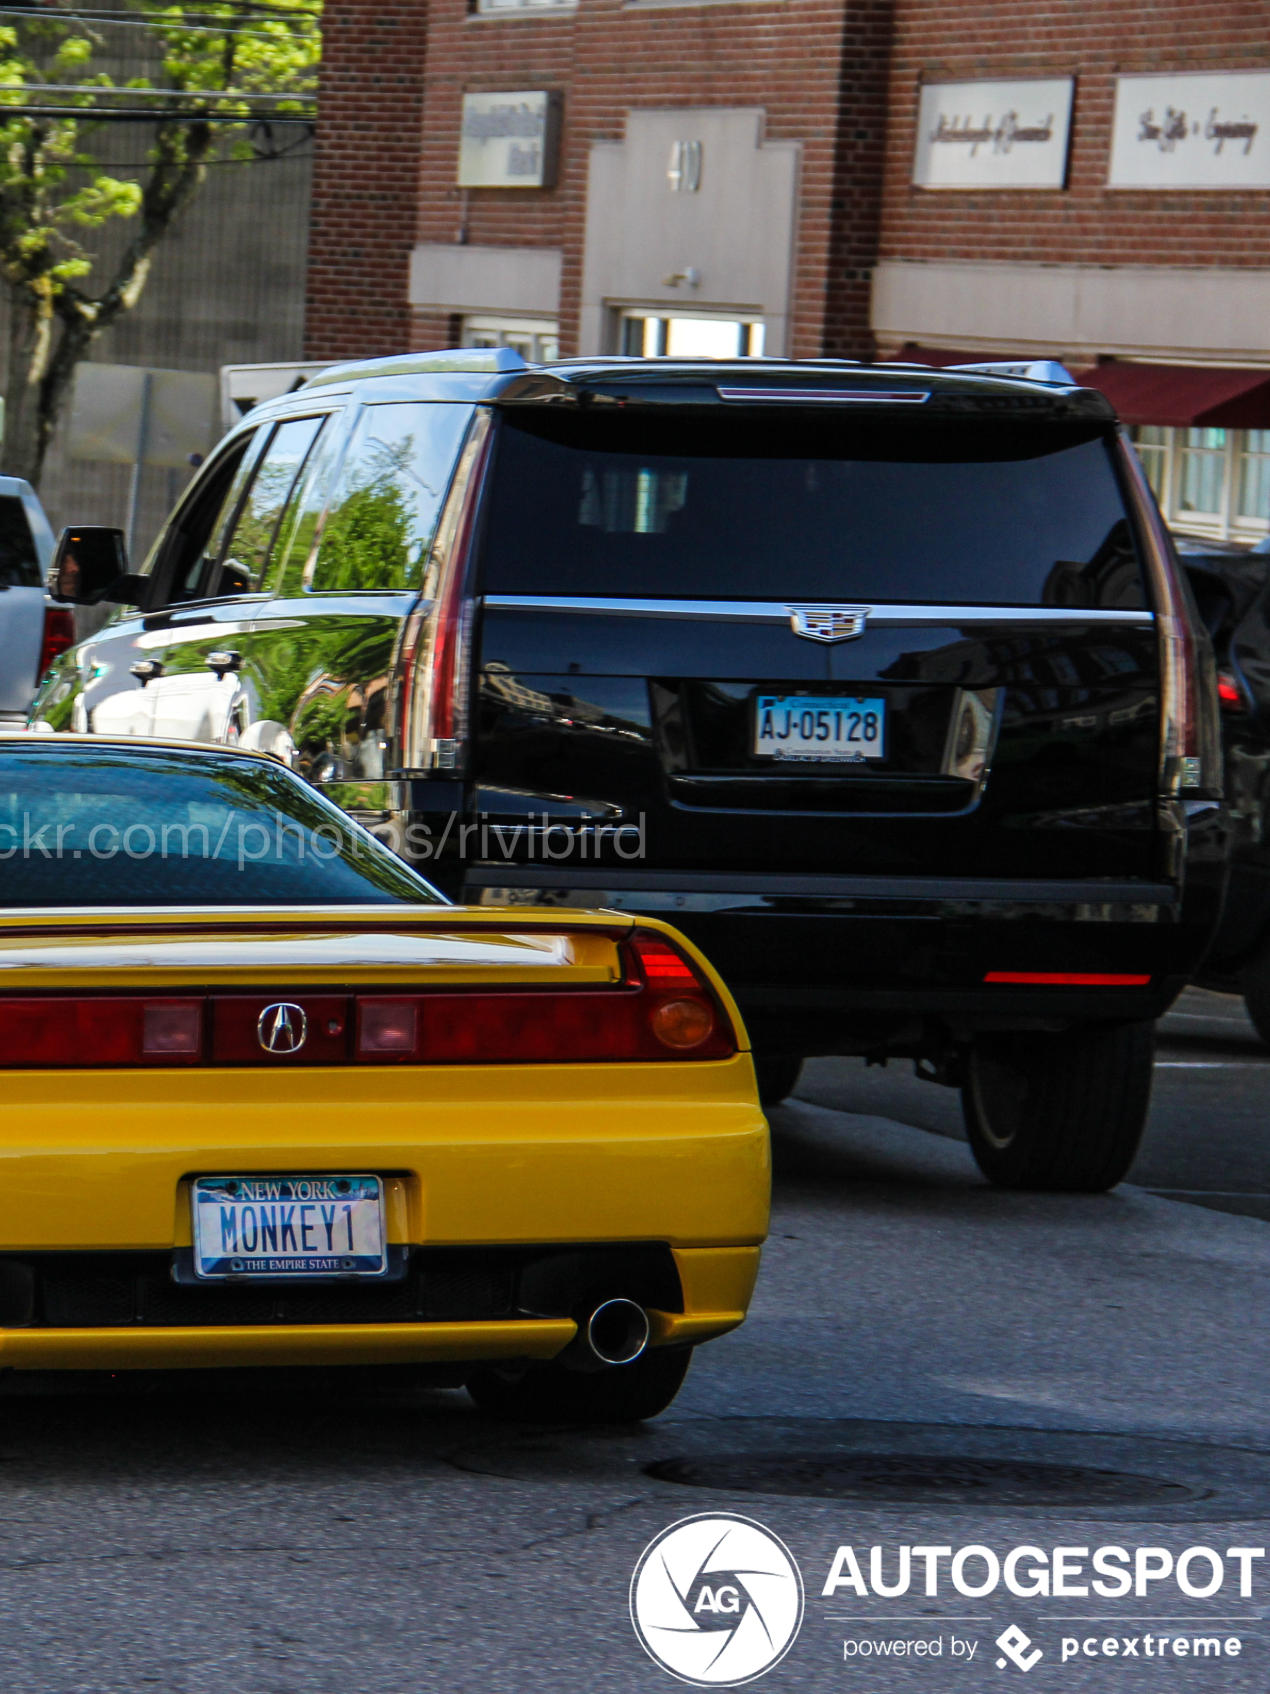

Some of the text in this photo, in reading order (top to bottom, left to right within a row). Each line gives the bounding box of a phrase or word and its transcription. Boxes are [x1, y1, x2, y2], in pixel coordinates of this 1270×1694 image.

[667, 140, 702, 192] 40
[241, 1181, 337, 1201] NEW YORK
[220, 1204, 354, 1253] MONKEY1
[245, 1259, 340, 1270] THE EMPIRE STATE
